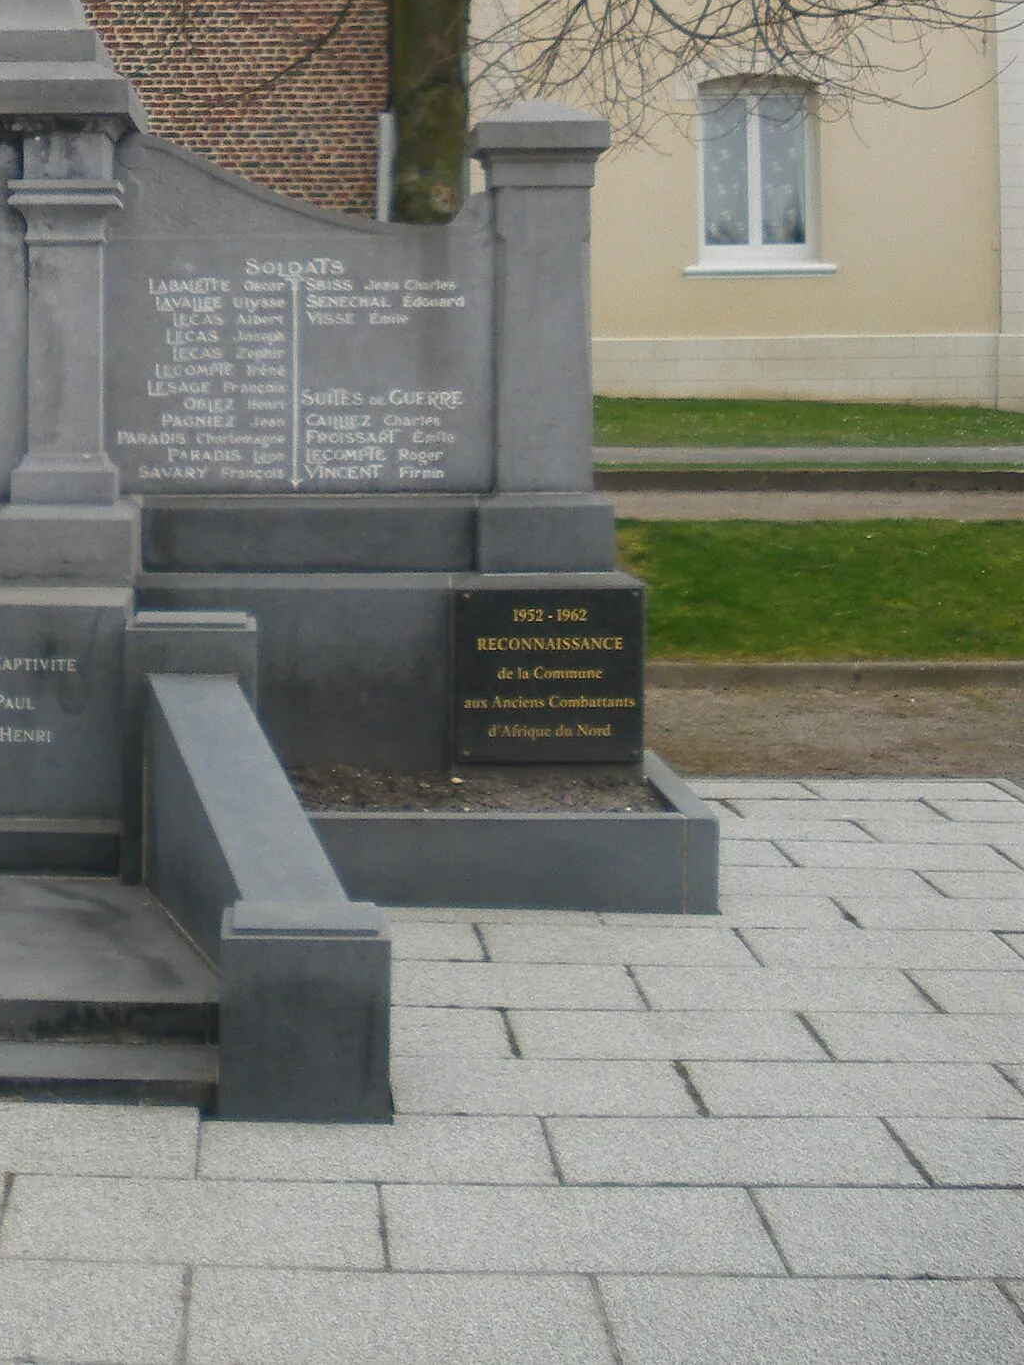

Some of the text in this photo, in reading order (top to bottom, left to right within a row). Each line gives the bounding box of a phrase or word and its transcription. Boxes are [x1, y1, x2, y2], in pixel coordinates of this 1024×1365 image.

[245, 258, 345, 277] SOLDATS
[172, 311, 225, 327] LECAS
[166, 328, 220, 345] LECAS
[172, 345, 223, 362] LECAS
[147, 380, 211, 397] LESAGE
[301, 388, 463, 410] SUITES GUERRE
[117, 431, 187, 445] PARADIS
[167, 447, 242, 463] PARADIS
[398, 449, 444, 466] Roger
[138, 465, 208, 480] SAVARY
[304, 465, 384, 480] VINCENT
[513, 609, 587, 622] 1952 1962
[477, 637, 624, 651] RECONNAISSANCE
[497, 666, 603, 680] de la Commune
[464, 695, 636, 709] aux Anciens Combattants
[0, 726, 51, 743] HENRI
[555, 724, 573, 737] du
[577, 723, 612, 737] Nord
